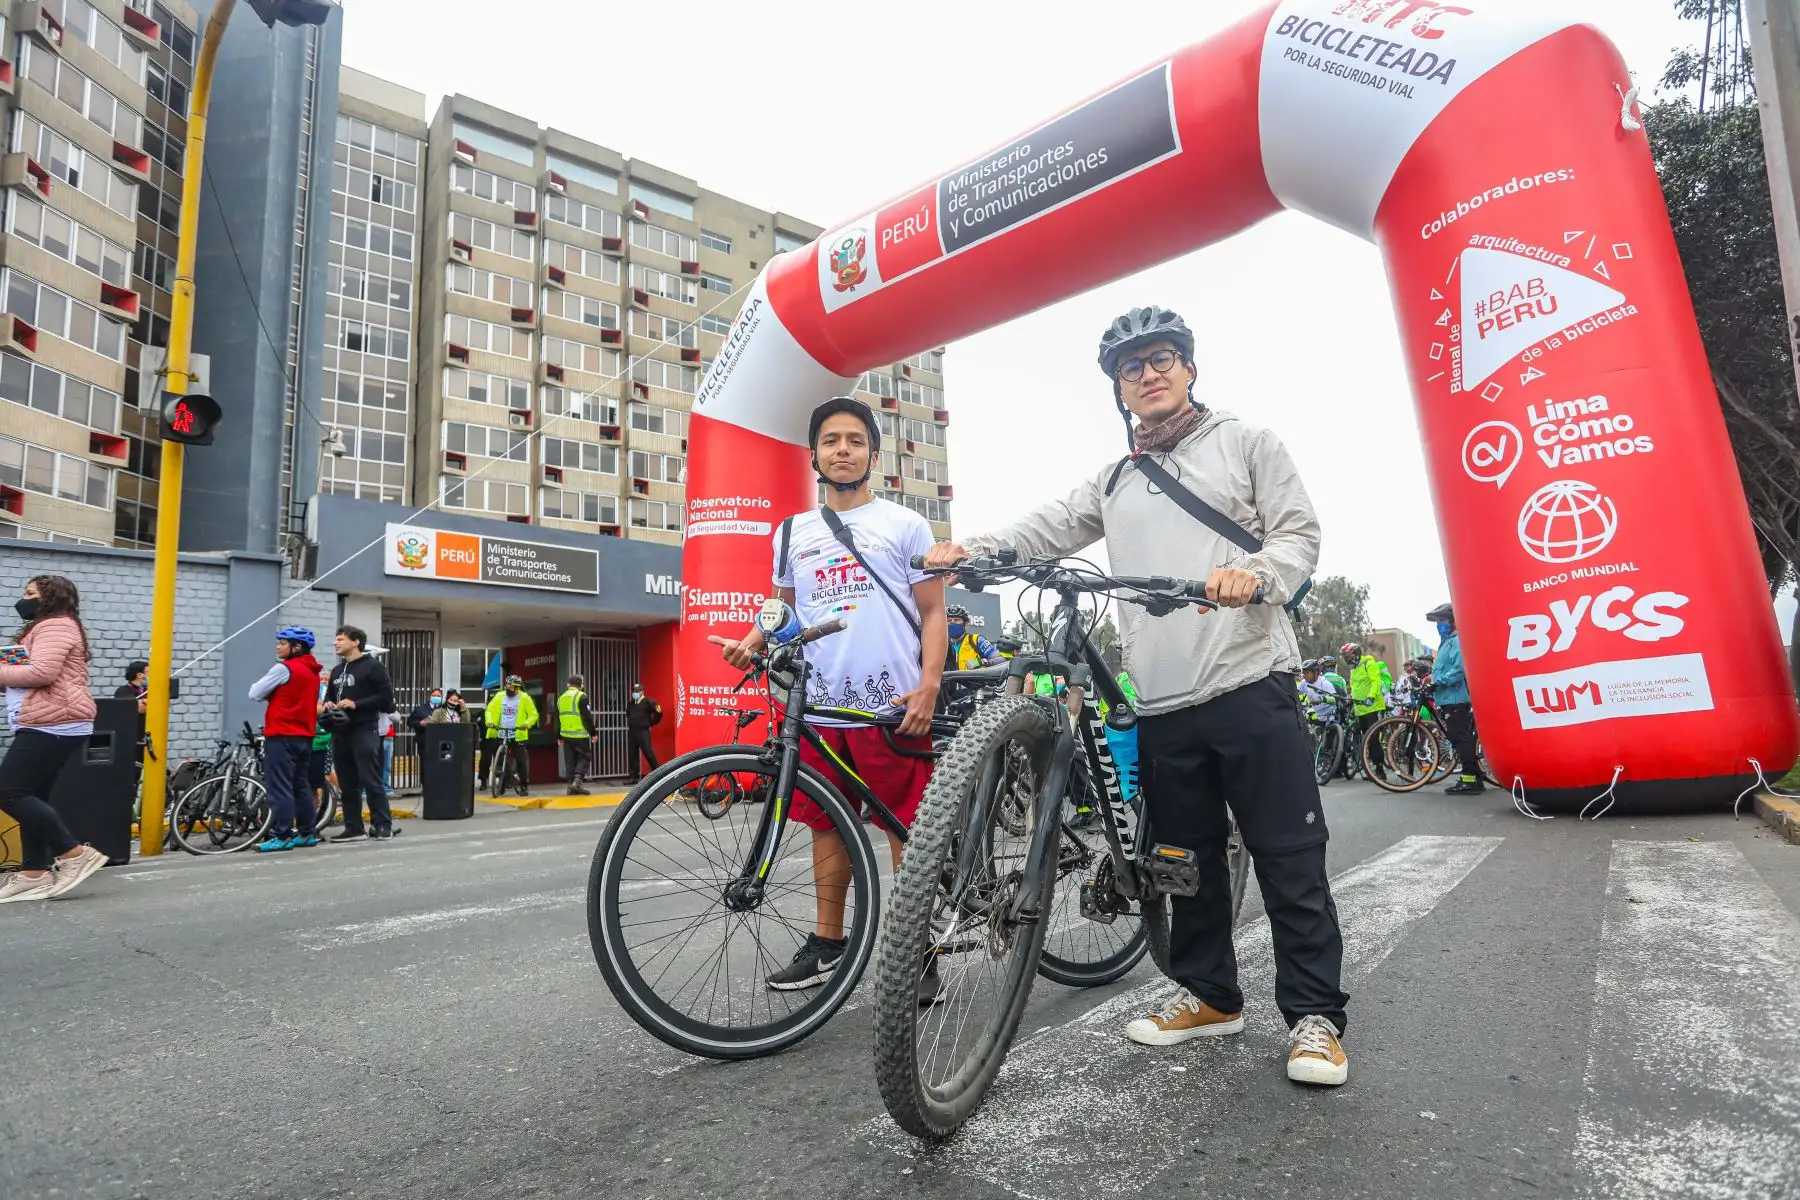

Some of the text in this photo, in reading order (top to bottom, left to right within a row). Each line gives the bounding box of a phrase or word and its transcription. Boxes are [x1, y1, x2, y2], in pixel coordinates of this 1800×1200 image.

[1276, 15, 1457, 85] BICICLETEADA
[1284, 47, 1415, 99] POR LA SEGURIDAD VIAL
[949, 144, 1031, 194] Ministerio
[949, 141, 1074, 212] de Transportes
[949, 148, 1108, 238] y Comunicaciones
[1421, 168, 1575, 240] Colaboradores:
[882, 205, 929, 249] PERÚ
[1469, 234, 1571, 268] arquitectura
[1474, 277, 1545, 319] #BAB
[1477, 292, 1558, 340] PERÚ
[1521, 303, 1638, 363] de la bicicleta
[698, 298, 762, 405] BICICLETEADA
[711, 383, 724, 400] POR
[721, 375, 729, 387] LA
[726, 334, 752, 375] SEGURIDAD
[748, 317, 762, 335] VIAL
[1449, 323, 1462, 394] Bienal de
[1526, 394, 1609, 427] Lima
[1533, 414, 1634, 446] Cómo
[1536, 435, 1654, 468] Vamos
[690, 496, 771, 510] Observatorio
[690, 507, 738, 523] Nacional
[696, 523, 738, 532] Seguridad
[740, 524, 758, 532] Vial
[440, 548, 475, 564] PERÚ
[487, 543, 536, 558] Ministerio
[487, 555, 557, 571] de Transportes
[487, 566, 572, 583] y Comunicaciones
[1523, 561, 1639, 593] BANCO MUNDIAL
[688, 589, 765, 610] Siempre
[811, 582, 875, 602] BICICLETEADA
[688, 607, 758, 626] con el puebl
[1506, 585, 1689, 662] BYCS
[689, 696, 737, 706] DEL PERÚ
[1525, 680, 1602, 714] LUM
[1607, 682, 1631, 690] LUGAR
[1619, 686, 1665, 696] TOLERANCIA
[1668, 691, 1694, 699] SOCIAL
[689, 708, 705, 716] 2021
